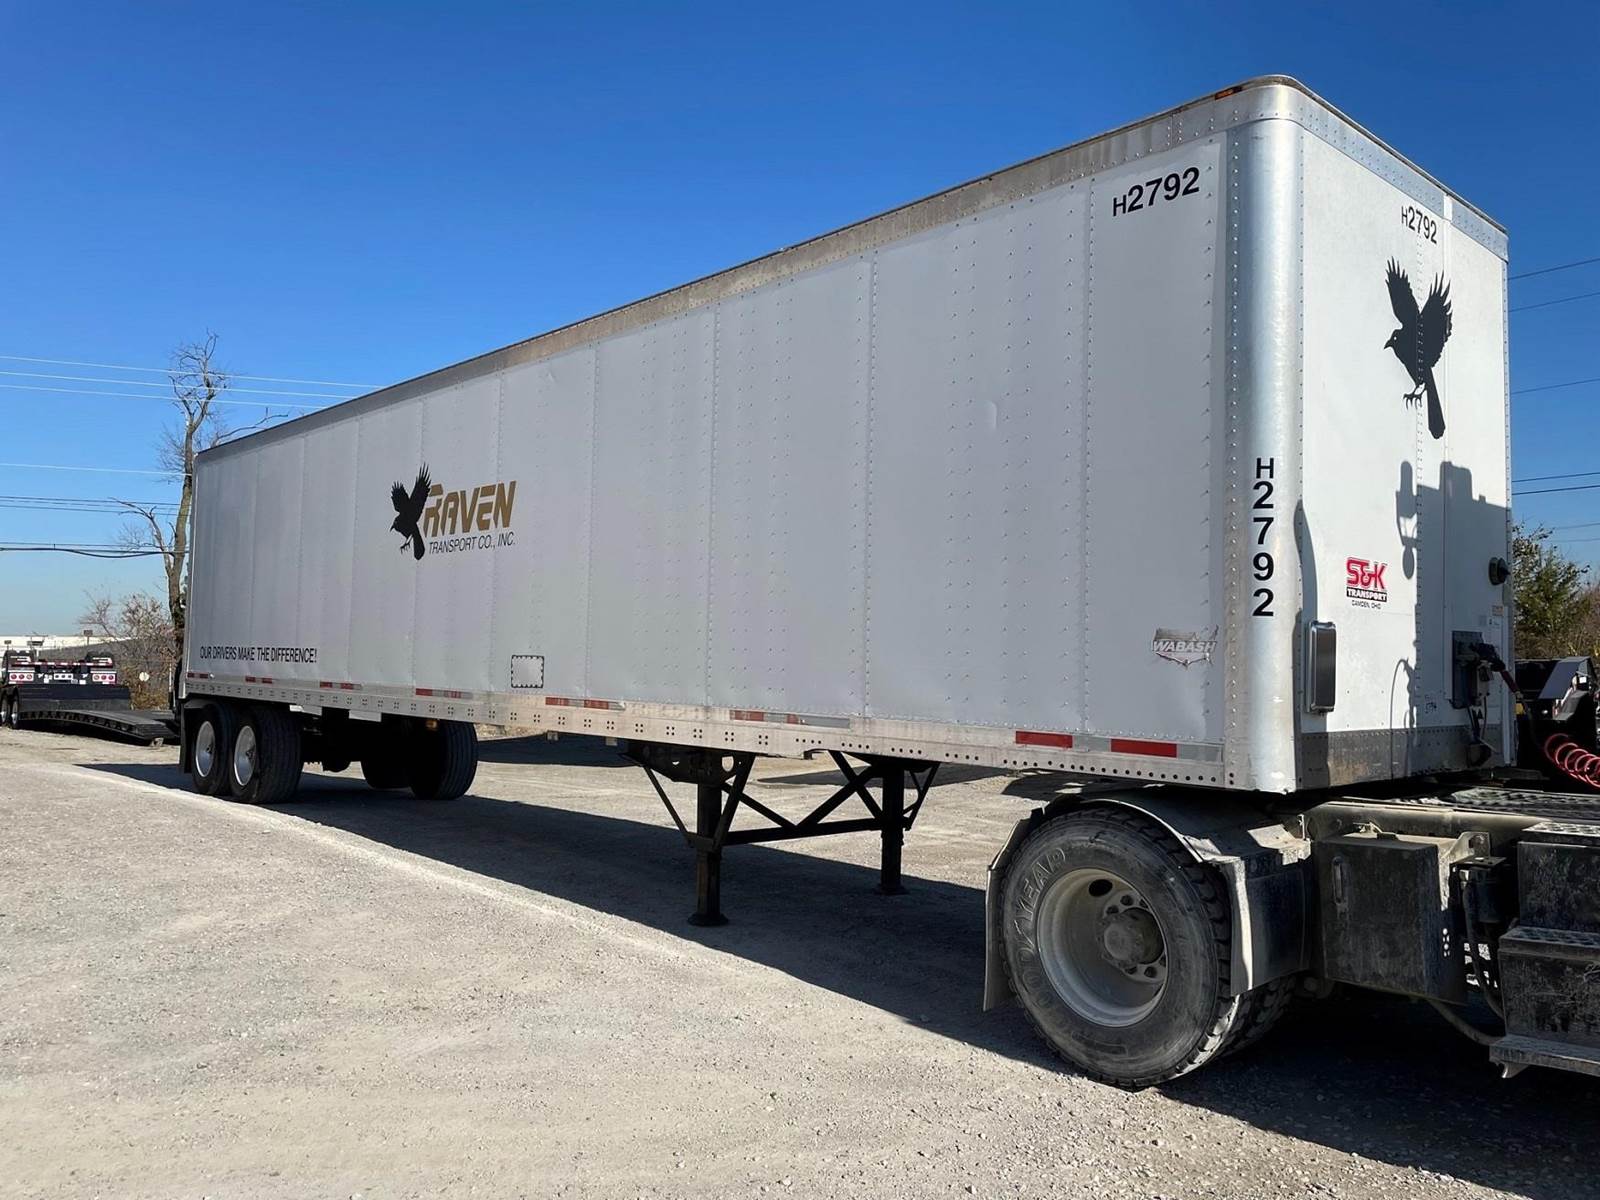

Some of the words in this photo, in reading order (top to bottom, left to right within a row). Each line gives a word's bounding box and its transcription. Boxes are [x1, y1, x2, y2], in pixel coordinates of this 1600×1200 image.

[1113, 167, 1200, 216] H2792
[1401, 205, 1437, 244] H2792
[423, 481, 516, 538] RAVEN
[429, 537, 477, 554] TRANSPORT
[498, 532, 516, 547] INC.
[1253, 458, 1274, 617] H2792
[1346, 557, 1387, 589] S&K
[1347, 588, 1387, 602] TRANSPORT
[200, 646, 211, 659] OUR
[213, 646, 237, 660] DRIVERS
[238, 647, 255, 661] MAKE
[257, 647, 269, 661] THE
[271, 647, 317, 663] DIFFERENCE!
[1153, 640, 1217, 653] WABASH
